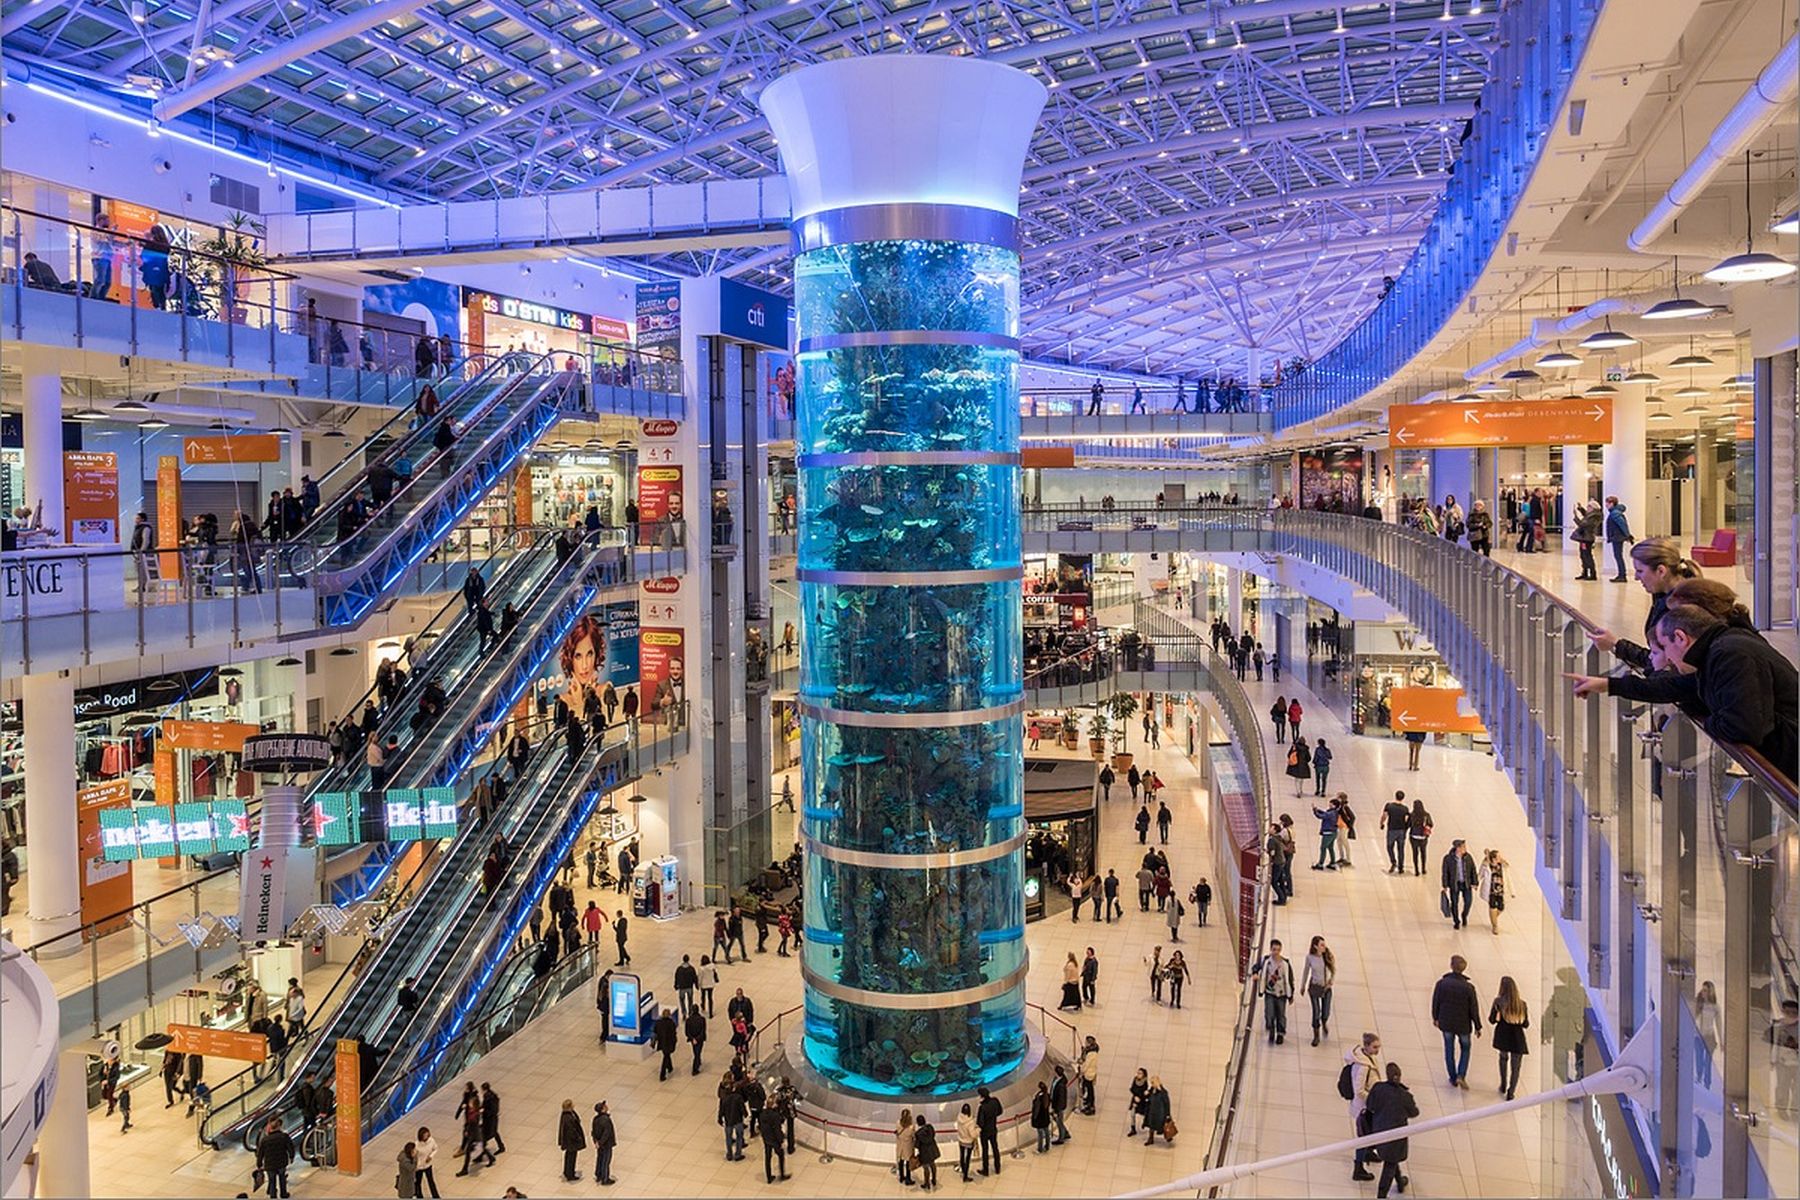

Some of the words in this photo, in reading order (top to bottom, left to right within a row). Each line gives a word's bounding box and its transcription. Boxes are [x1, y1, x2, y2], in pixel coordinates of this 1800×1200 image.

[482, 295, 498, 313] ds
[503, 299, 557, 326] O'STIN
[560, 312, 584, 331] kids
[748, 307, 765, 327] citi
[106, 456, 113, 467] 3
[2, 562, 63, 597] ENCE
[1026, 596, 1054, 604] COFFEE
[104, 688, 136, 708] Road
[118, 785, 126, 797] 2
[256, 873, 272, 934] Heineken
